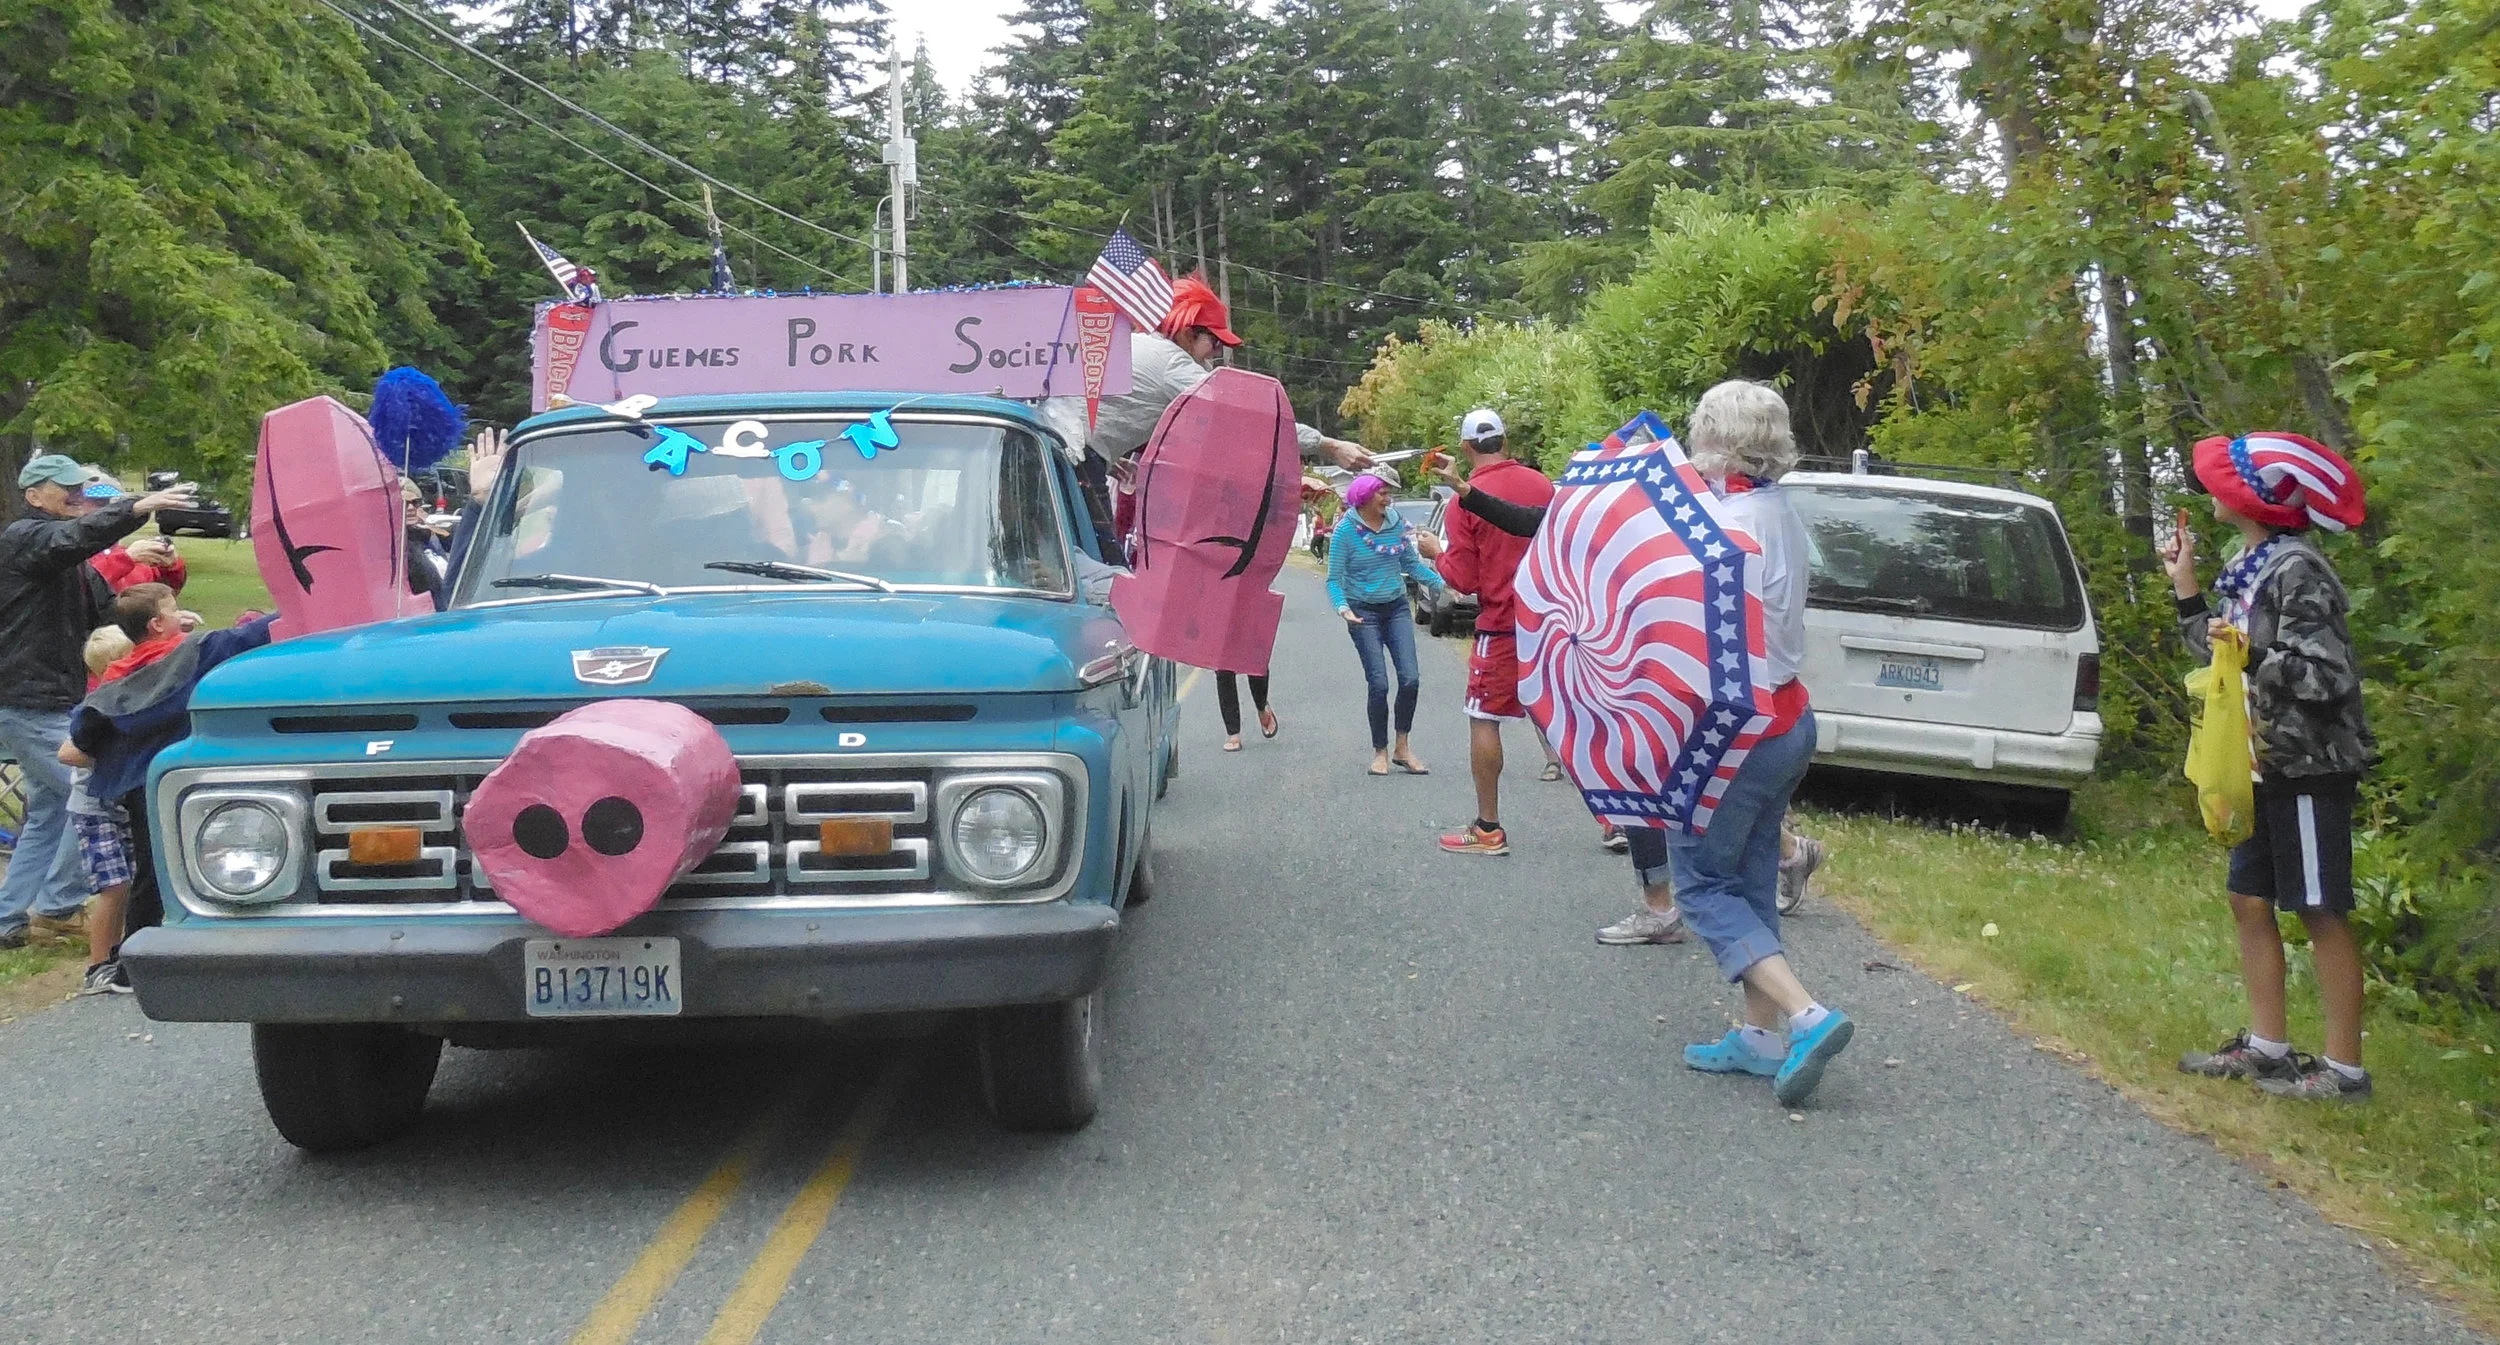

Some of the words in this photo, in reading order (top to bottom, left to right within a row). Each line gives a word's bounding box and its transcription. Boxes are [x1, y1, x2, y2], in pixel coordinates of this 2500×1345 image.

[600, 321, 740, 373] GUEMES
[788, 317, 880, 367] PORK
[1077, 312, 1116, 399] BACON
[1880, 664, 1939, 685] ARK0943
[537, 950, 621, 961] WASHINGTON
[535, 965, 672, 1004] B13719K
